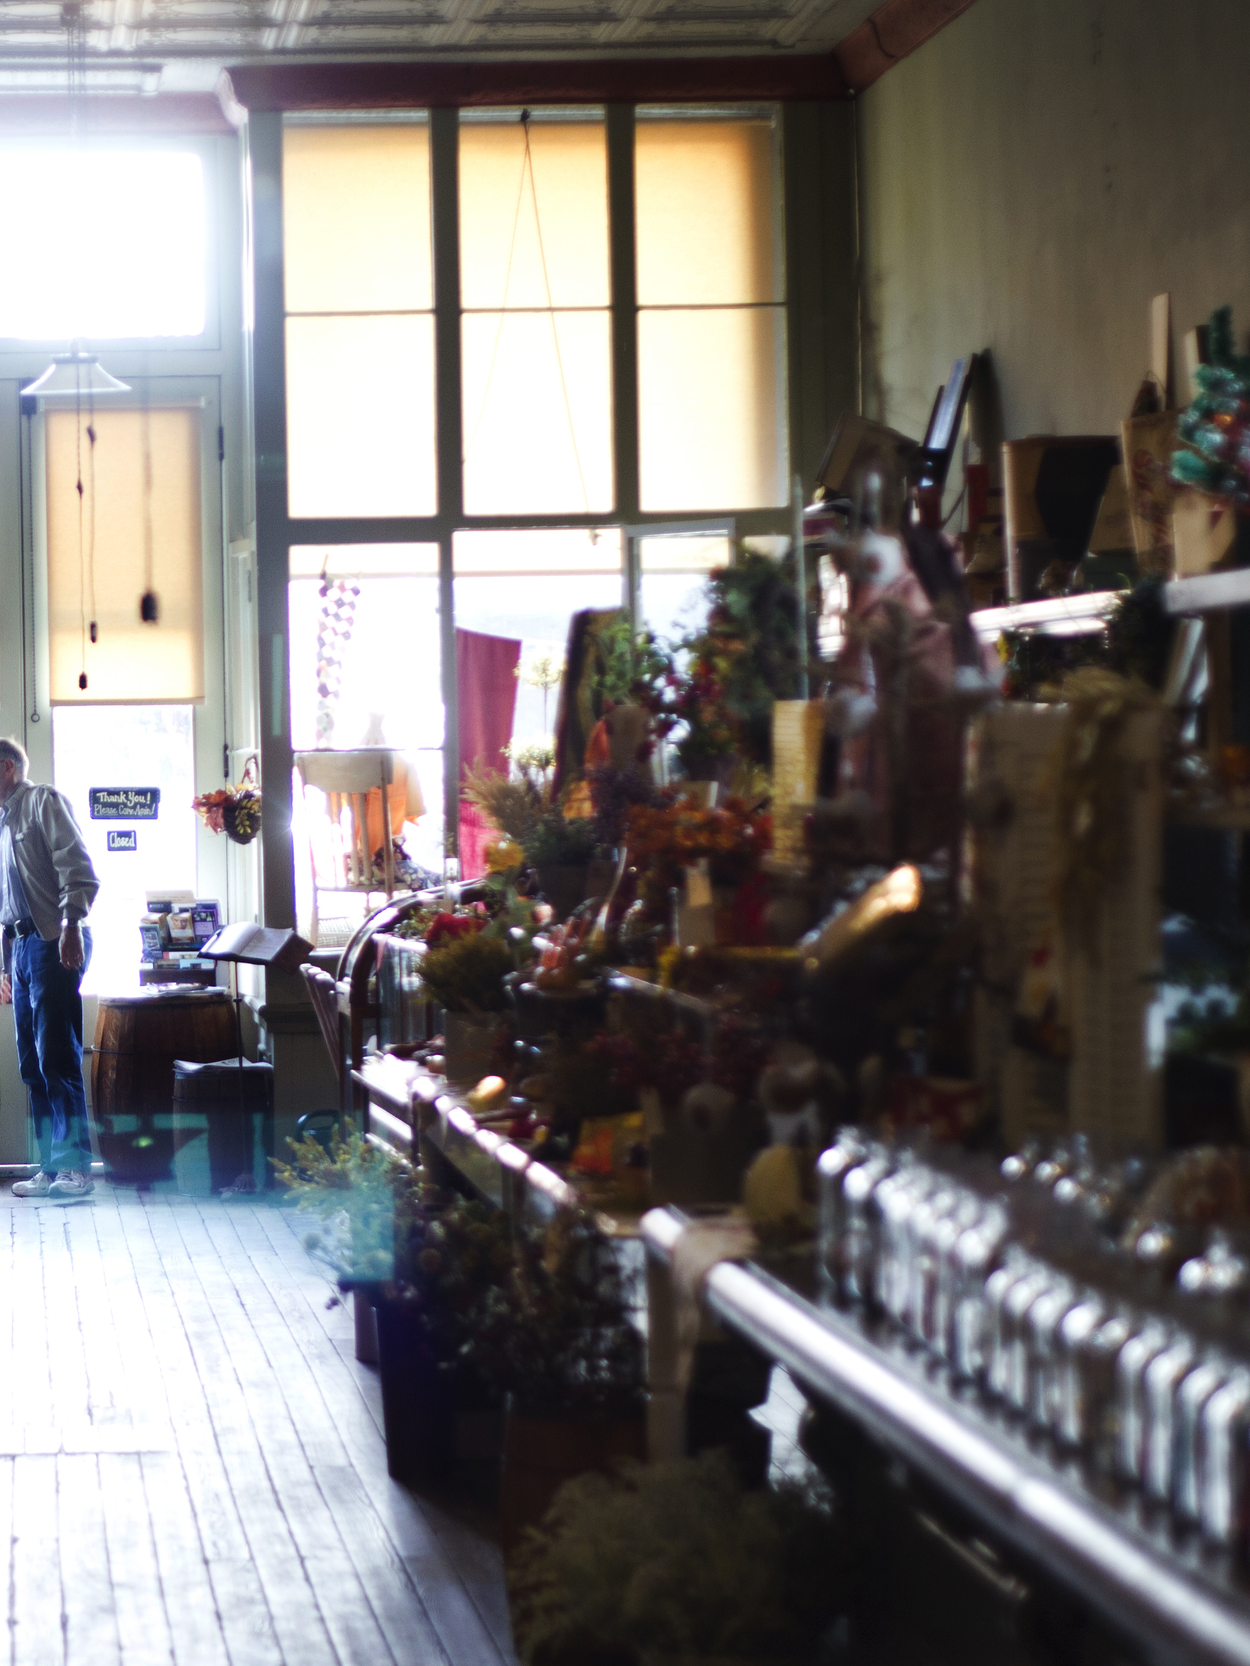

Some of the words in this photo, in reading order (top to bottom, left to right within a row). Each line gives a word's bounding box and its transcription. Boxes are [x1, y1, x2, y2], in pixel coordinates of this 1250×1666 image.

[96, 791, 127, 803] Thank
[94, 804, 118, 815] Please
[119, 804, 134, 815] Come
[134, 803, 155, 816] Again!
[109, 832, 135, 848] Closed
